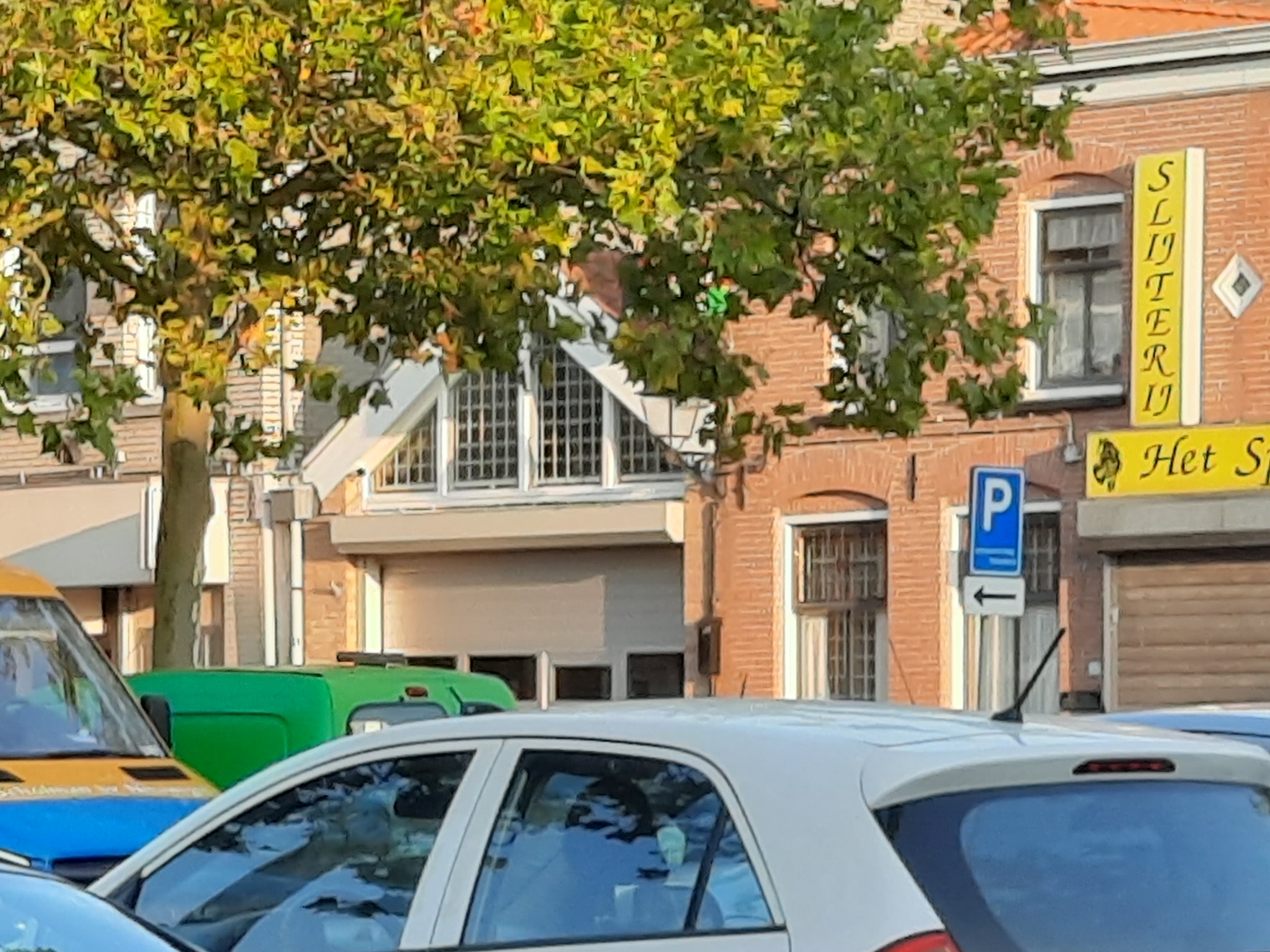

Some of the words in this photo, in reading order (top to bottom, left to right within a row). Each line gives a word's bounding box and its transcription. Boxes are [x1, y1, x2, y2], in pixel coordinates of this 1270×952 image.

[1140, 160, 1176, 416] SLIJTERIJ
[1139, 434, 1216, 480] Het
[982, 477, 1013, 533] P
